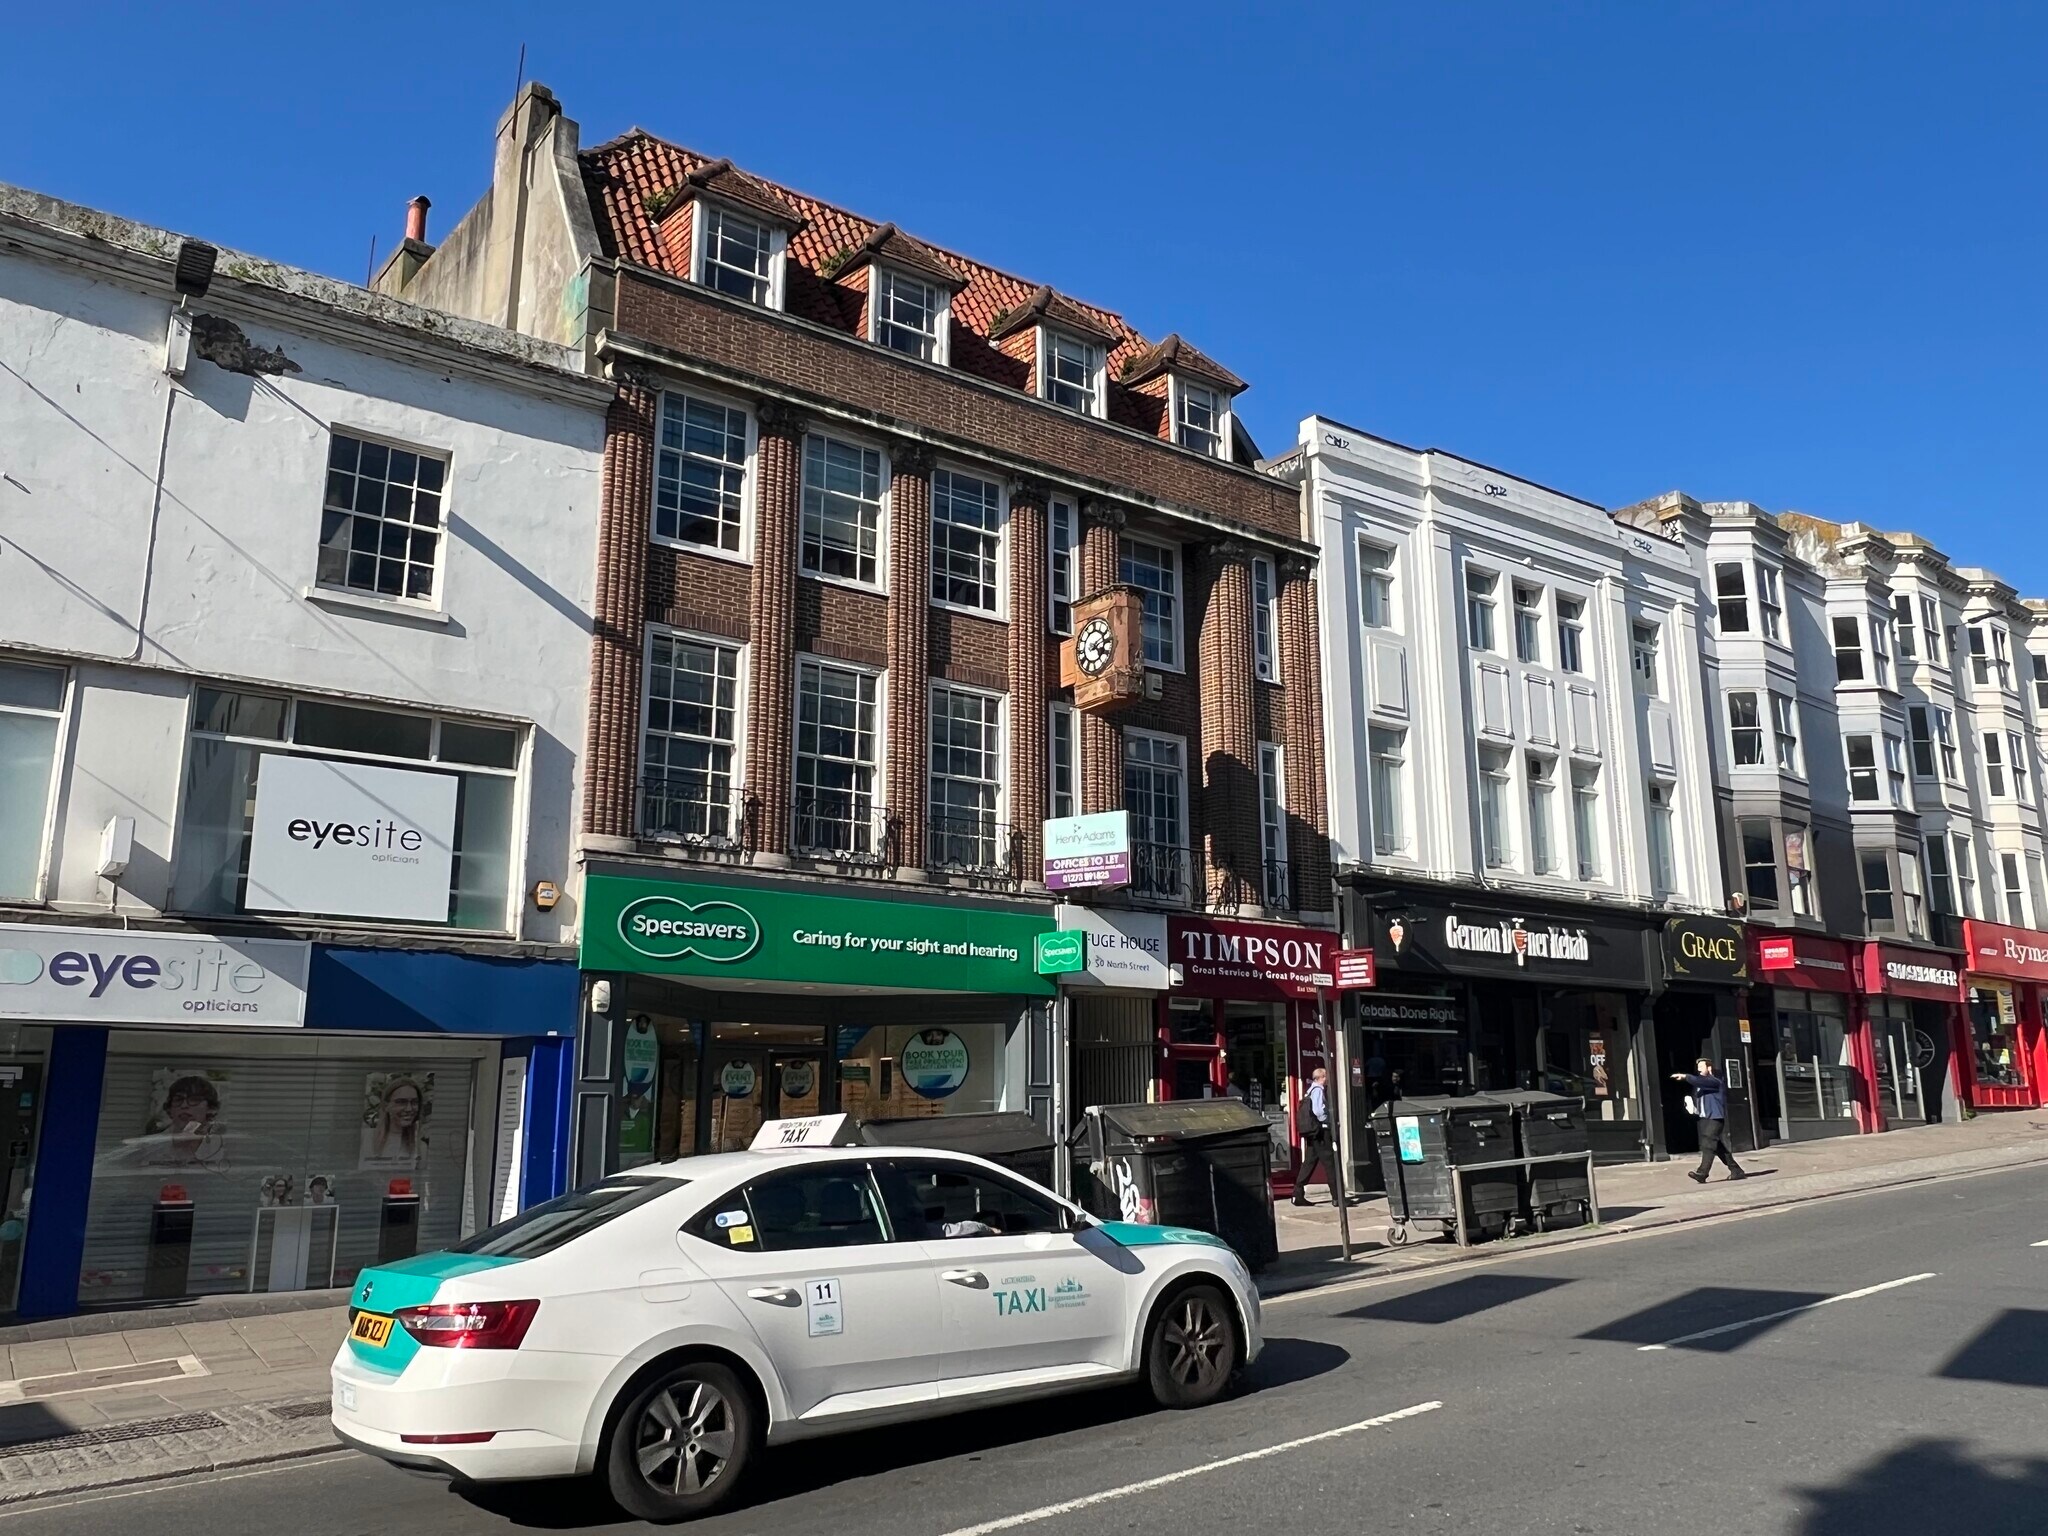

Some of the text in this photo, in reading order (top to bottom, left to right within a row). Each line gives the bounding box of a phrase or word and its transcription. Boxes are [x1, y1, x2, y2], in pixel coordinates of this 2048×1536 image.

[287, 818, 422, 851] eyesite
[1055, 830, 1116, 845] Henry Adams
[371, 853, 419, 864] opticians
[1053, 857, 1089, 870] OFFICES
[1090, 856, 1104, 866] TO
[1105, 854, 1119, 864] LET
[632, 914, 747, 941] Specsavers
[792, 929, 1018, 961] Caring for your sight and hearing
[1120, 935, 1160, 952] HOUSE
[1445, 915, 1501, 953] German
[1547, 926, 1589, 961] Kebab
[1681, 931, 1737, 961] GRACE
[1044, 946, 1077, 958] Specsavers
[1181, 930, 1323, 970] TIMPSON
[49, 946, 265, 998] eyesite
[1107, 959, 1127, 970] North
[1129, 962, 1150, 972] Street
[1192, 964, 1216, 975] Great
[1218, 967, 1250, 978] Service
[1252, 969, 1264, 980] By
[1265, 971, 1288, 981] Great
[1290, 972, 1313, 983] Peopl
[182, 998, 259, 1013] opticians
[1400, 1005, 1427, 1019] Done
[905, 1049, 964, 1059] BOOK YOUR
[1590, 1054, 1606, 1066] OFF
[780, 1127, 810, 1144] TAXI
[816, 1283, 831, 1299] 11
[993, 1287, 1046, 1316] TAXI
